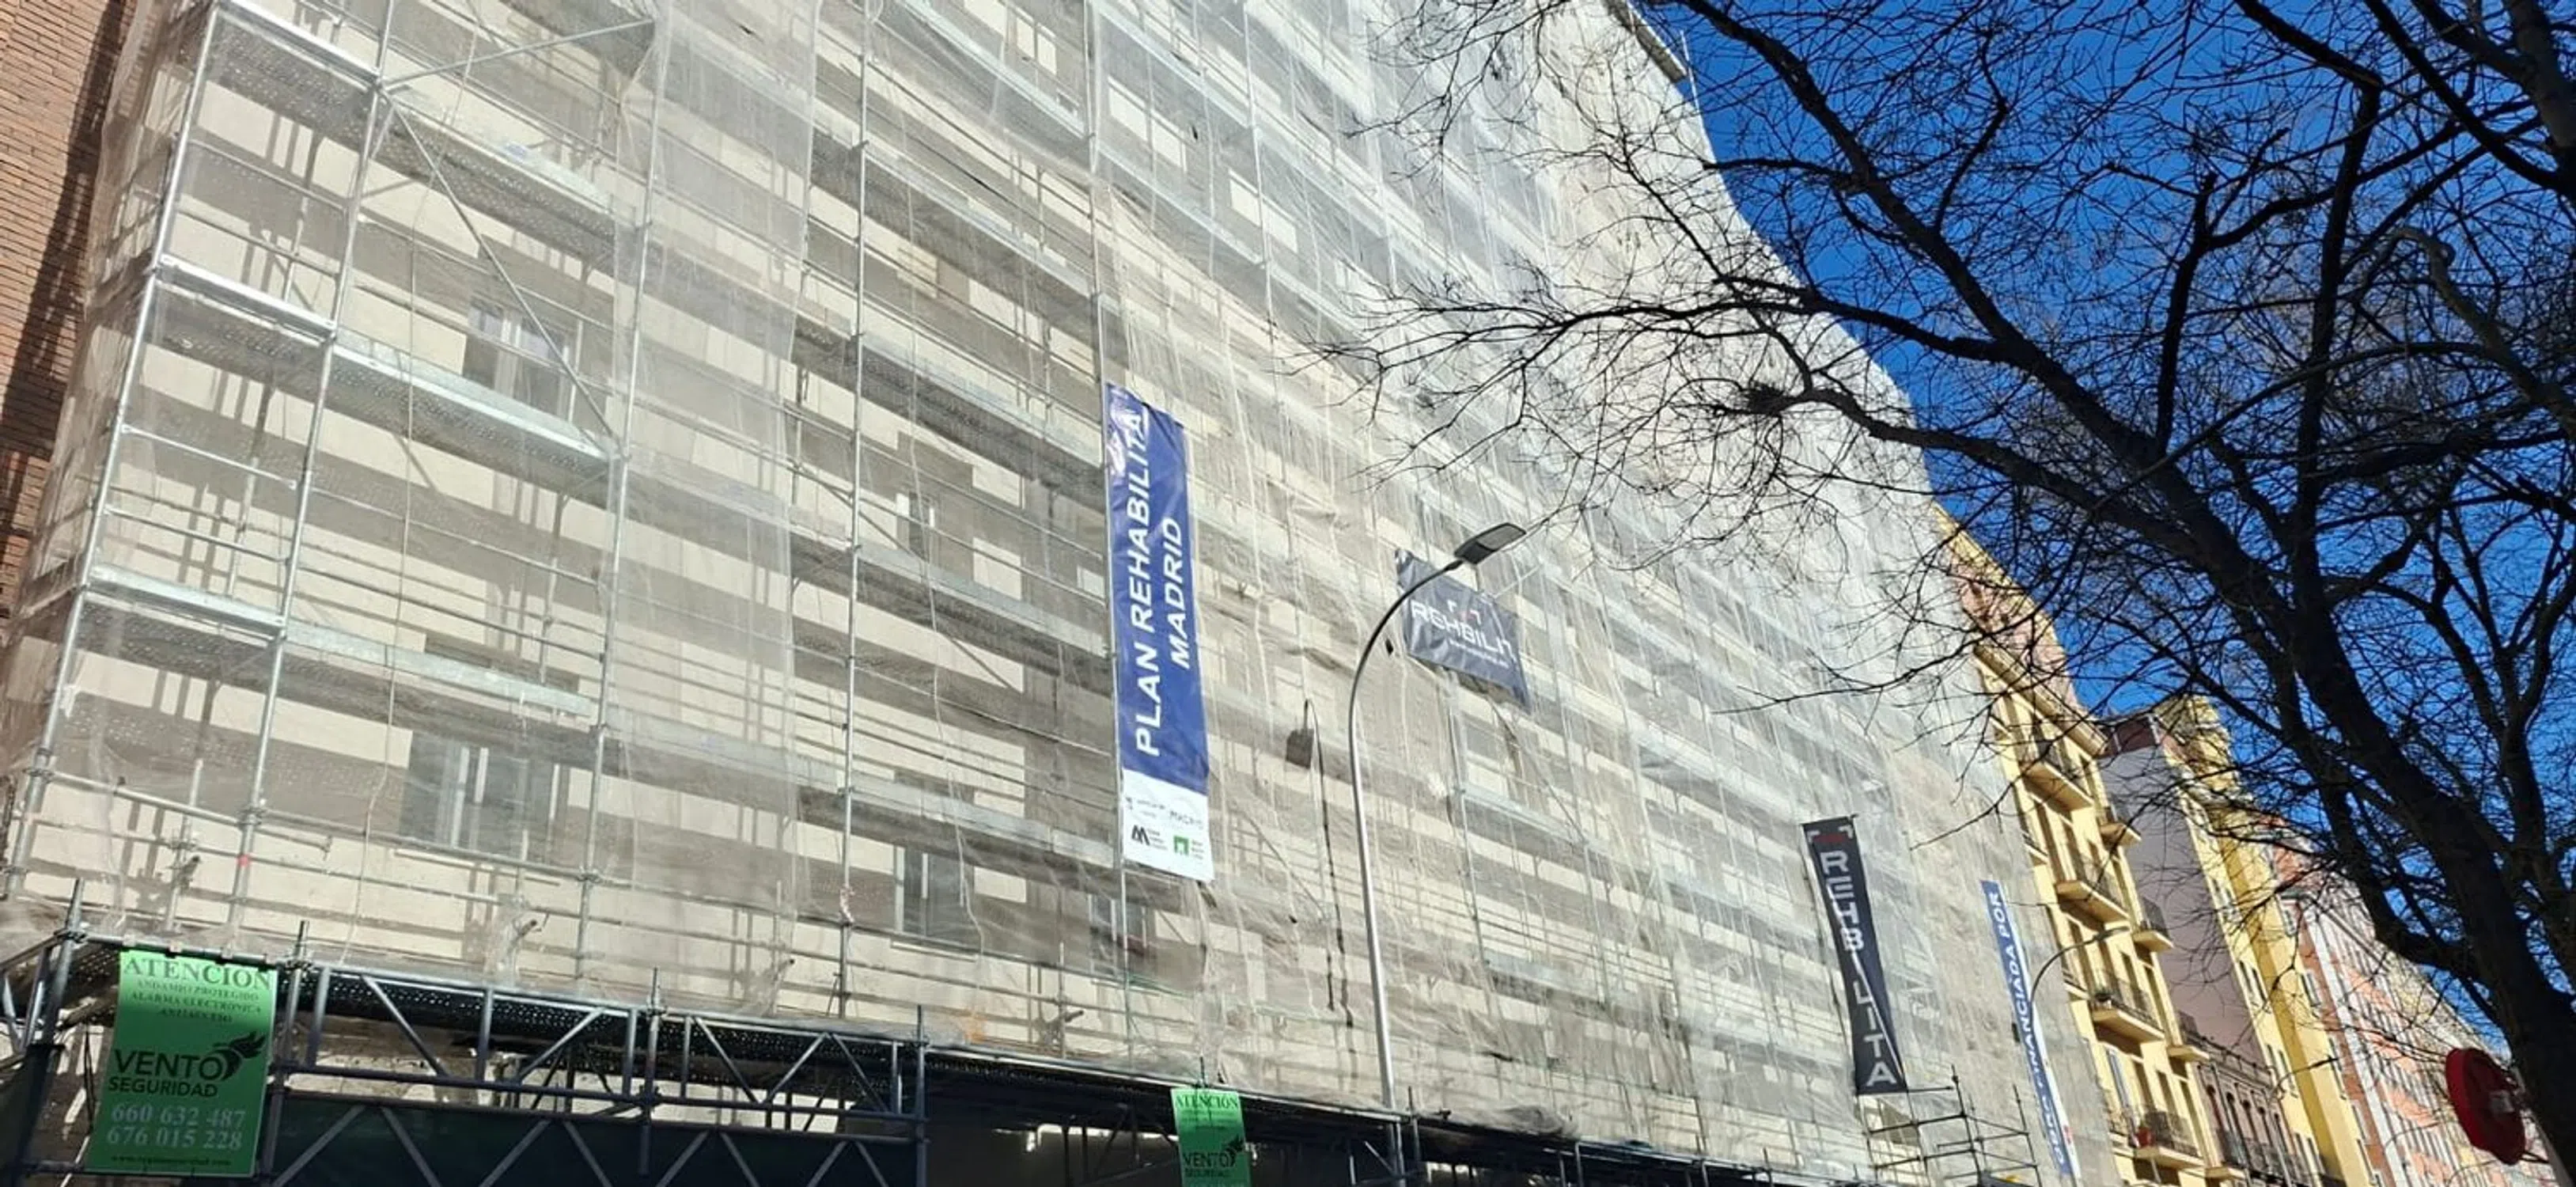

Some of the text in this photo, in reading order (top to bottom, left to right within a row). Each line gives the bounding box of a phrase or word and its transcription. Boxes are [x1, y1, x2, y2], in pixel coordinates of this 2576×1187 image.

[1125, 409, 1161, 757] PLAN REHABILITA
[1162, 518, 1191, 670] MADRID
[1989, 891, 2011, 937] POR
[123, 957, 270, 989] ATENCION
[132, 990, 180, 1004] ALARMA
[114, 1049, 222, 1081] VENTO
[108, 1077, 218, 1098] SEGURIDAD
[111, 1105, 246, 1128] 660 632 487
[107, 1126, 243, 1149] 676 015 228
[1184, 1152, 1227, 1167] VENTO
